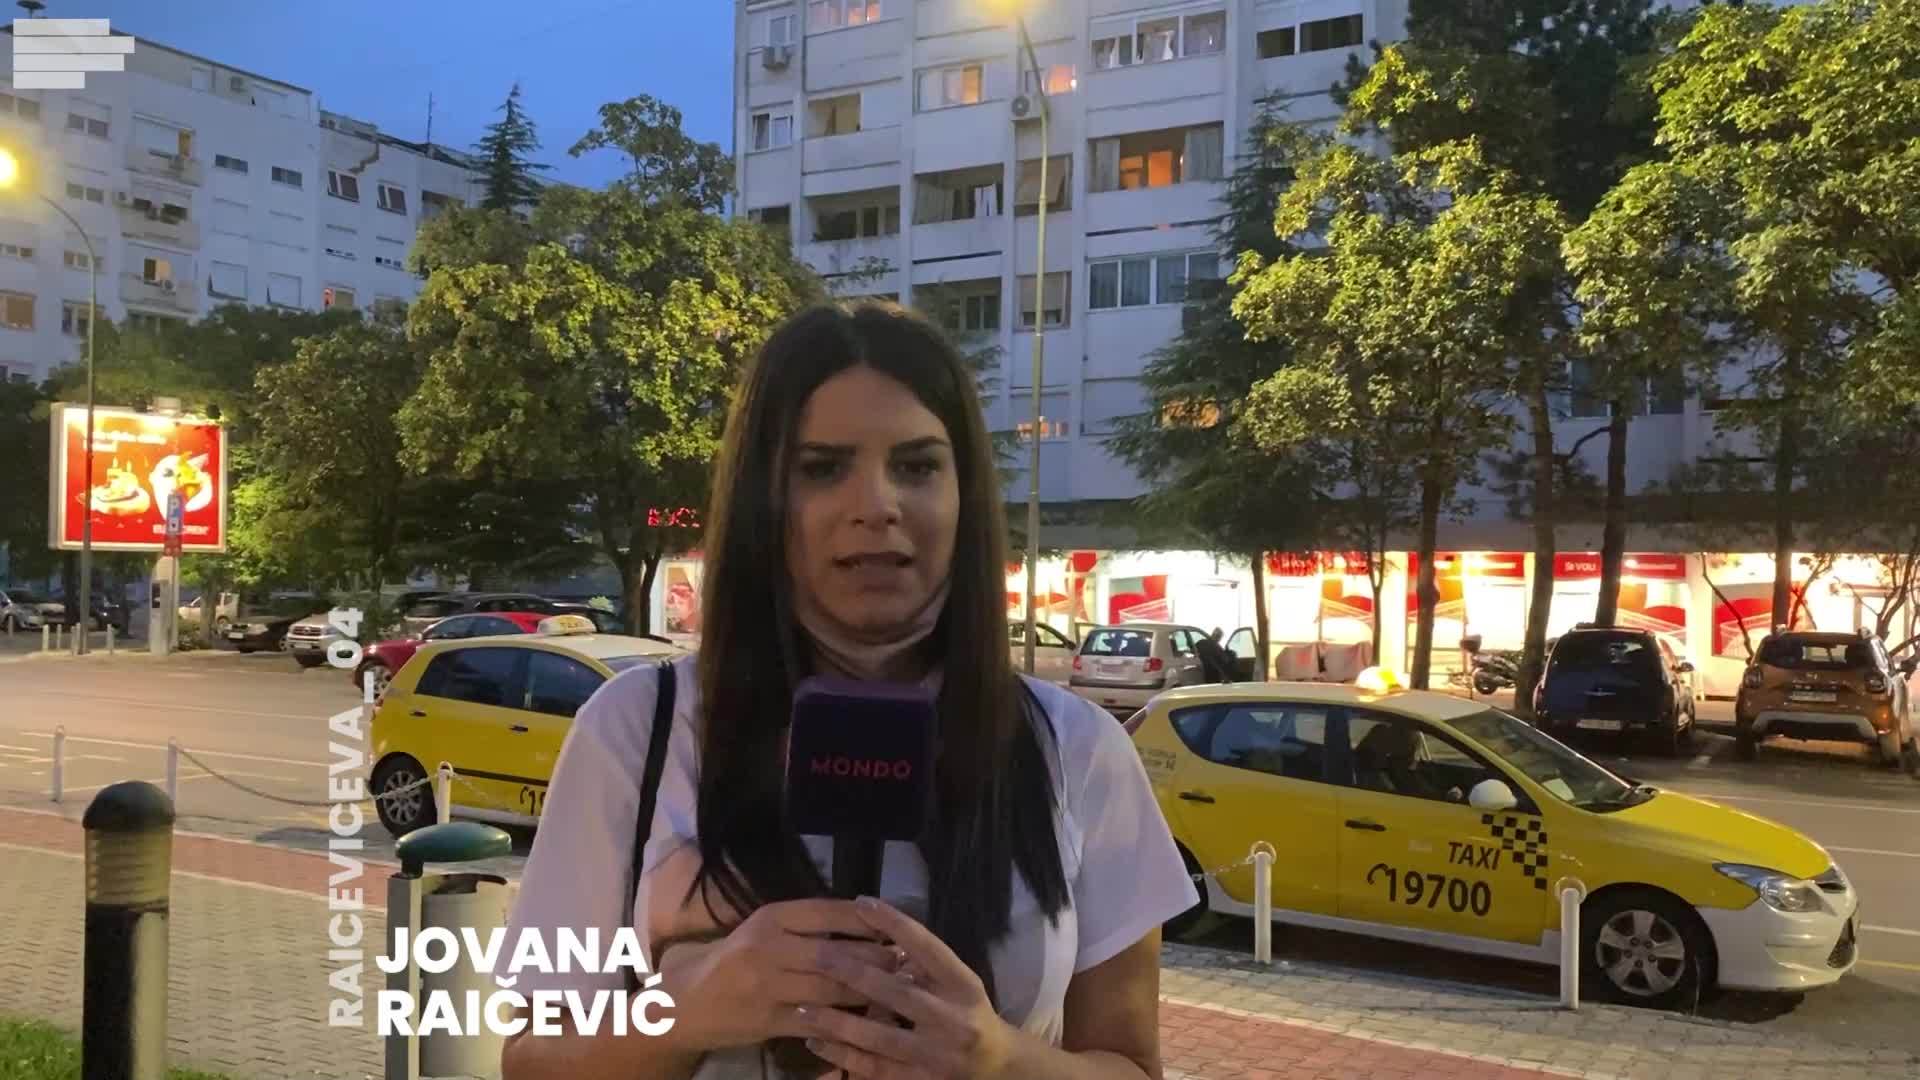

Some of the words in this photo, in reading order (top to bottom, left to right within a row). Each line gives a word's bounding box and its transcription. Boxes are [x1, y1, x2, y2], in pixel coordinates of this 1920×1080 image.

[810, 756, 912, 780] MONDO
[1448, 841, 1502, 871] TAXI
[1385, 867, 1492, 917] 19700
